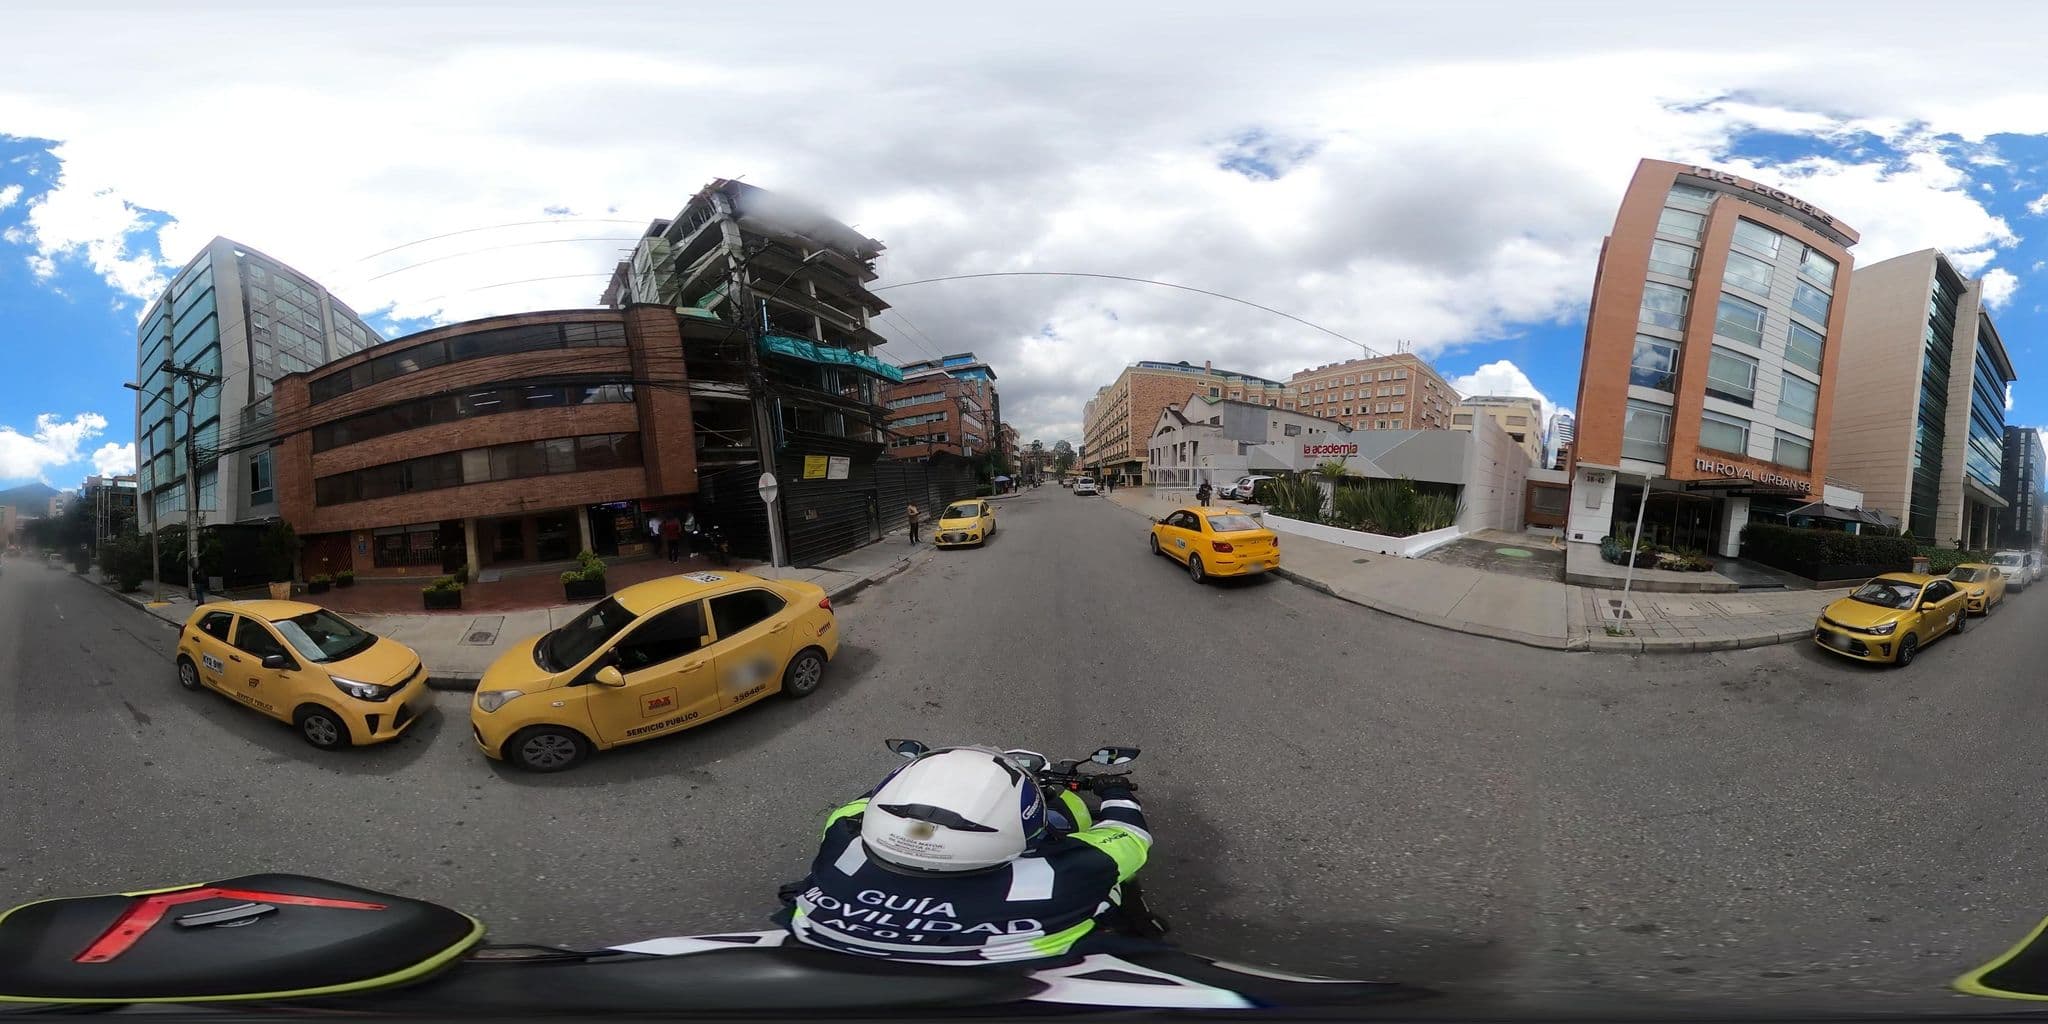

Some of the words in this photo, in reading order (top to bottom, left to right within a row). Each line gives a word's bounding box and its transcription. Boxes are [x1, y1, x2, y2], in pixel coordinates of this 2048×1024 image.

[1303, 443, 1311, 454] la
[1312, 442, 1358, 454] academia
[1716, 463, 1757, 481] ROYAL
[1760, 471, 1798, 490] URBAN
[1798, 481, 1811, 492] 93
[626, 722, 664, 737] SERVICIO
[804, 886, 1043, 934] MOVILIDAD
[856, 889, 957, 918] GUÍA
